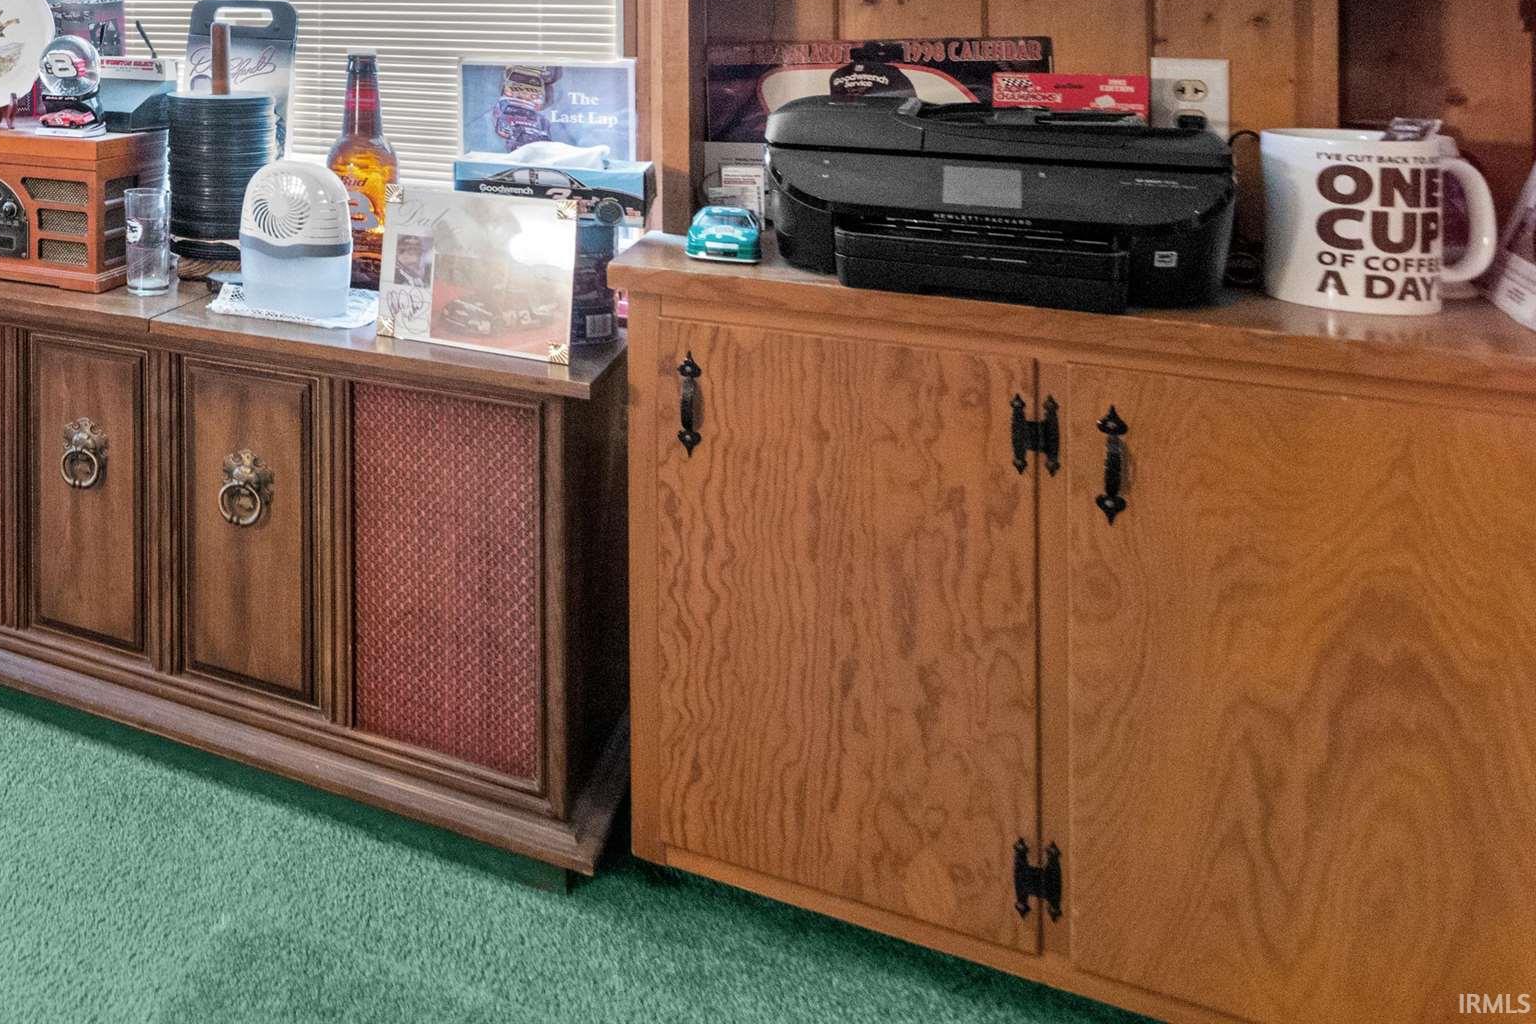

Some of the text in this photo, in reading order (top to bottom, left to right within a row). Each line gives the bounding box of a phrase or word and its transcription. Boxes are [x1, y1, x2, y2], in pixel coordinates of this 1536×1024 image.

[947, 40, 1042, 62] CALENDAR
[568, 91, 600, 106] The
[550, 110, 585, 124] Last
[587, 113, 619, 128] Lap
[1345, 153, 1373, 163] CUT
[1376, 155, 1409, 164] BACK
[479, 183, 534, 196] Goodwrench
[1317, 164, 1441, 209] ONE
[1316, 208, 1440, 254] CUP
[1317, 251, 1356, 268] OF
[1317, 269, 1437, 302] A DAY
